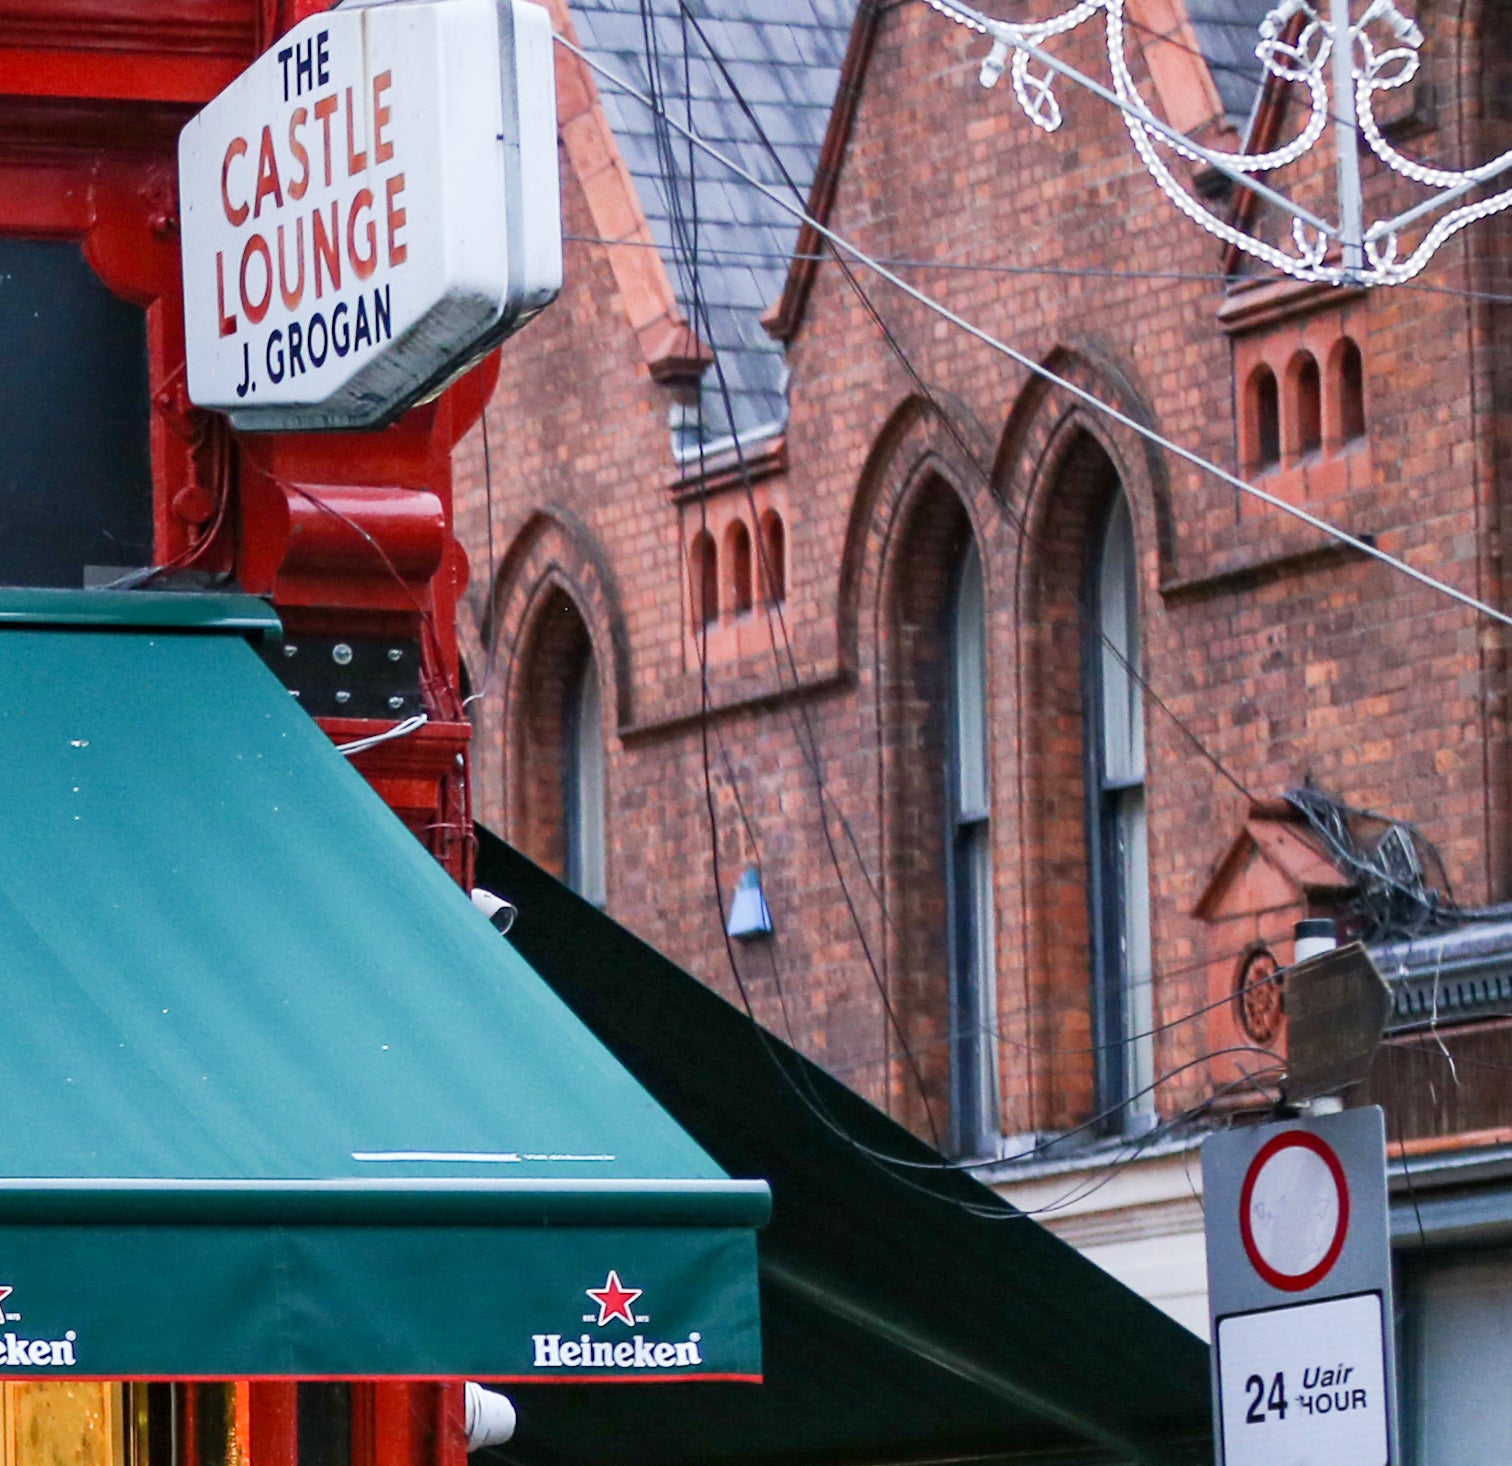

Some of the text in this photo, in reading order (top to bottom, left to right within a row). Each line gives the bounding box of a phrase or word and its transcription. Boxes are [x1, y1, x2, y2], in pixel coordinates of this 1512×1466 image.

[277, 28, 330, 102] THE
[220, 68, 395, 228] CASTLE
[215, 172, 408, 339] LOUNGE
[236, 283, 393, 398] J. GROGAN
[1245, 1362, 1354, 1425] 24 Uair
[1299, 1389, 1367, 1415] HOUR
